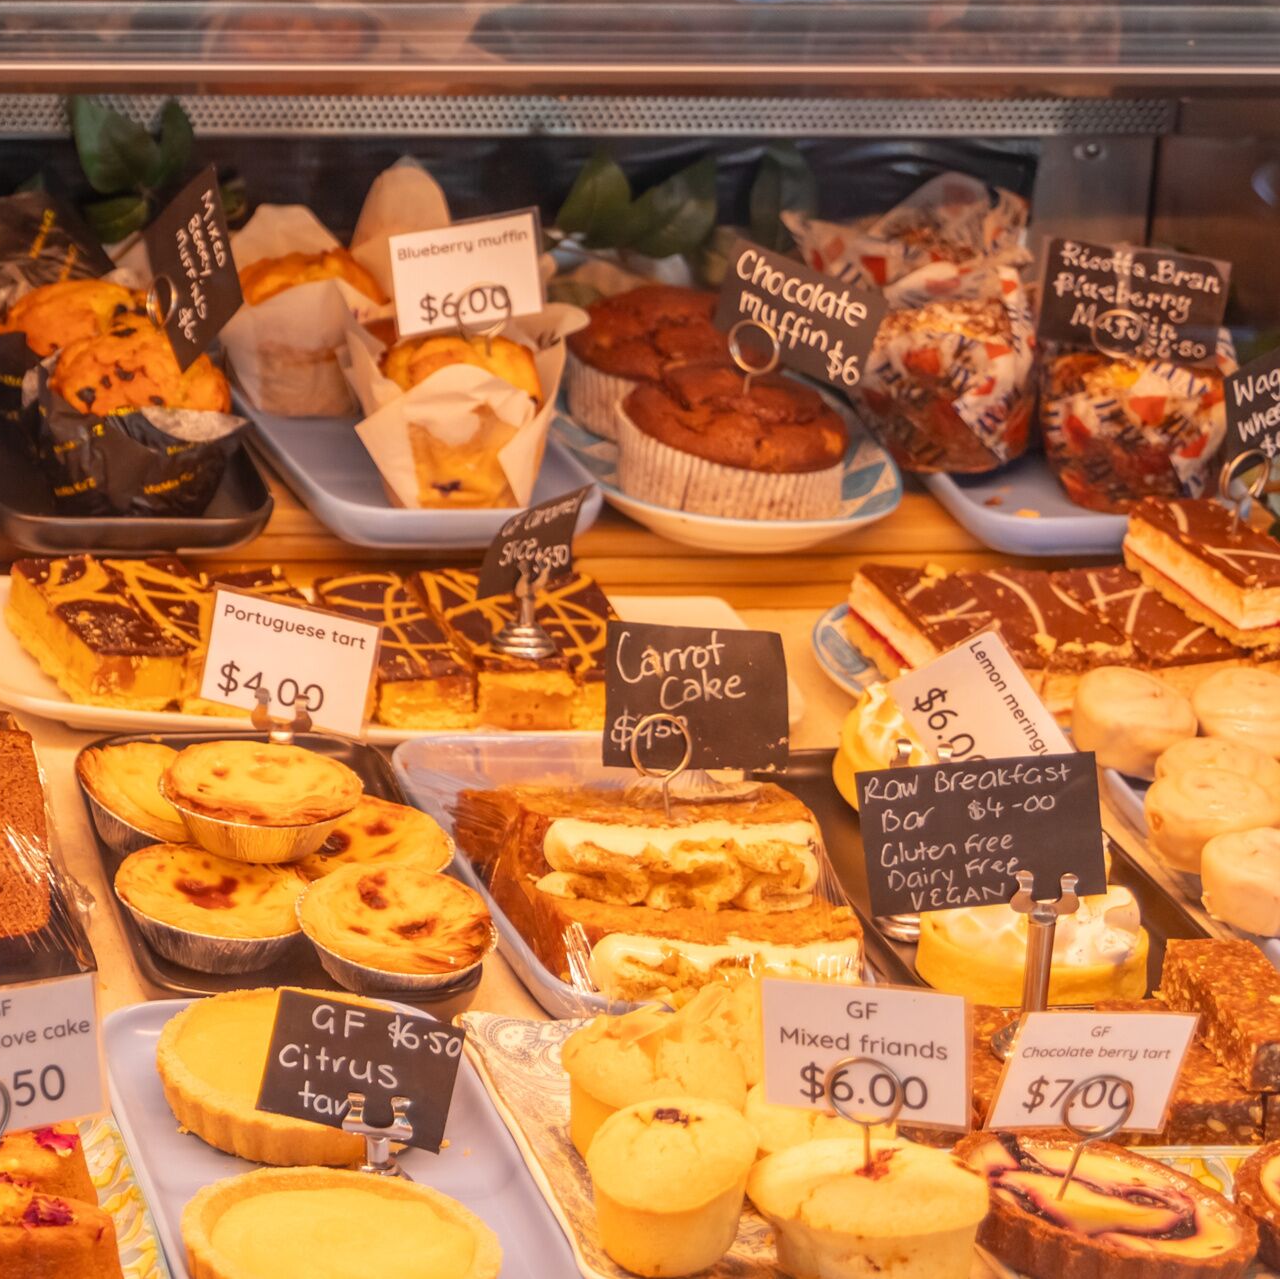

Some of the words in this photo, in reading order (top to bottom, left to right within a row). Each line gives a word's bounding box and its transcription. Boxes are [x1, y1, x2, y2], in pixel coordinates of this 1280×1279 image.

[397, 240, 474, 261] Blueberry
[478, 229, 528, 248] muffin
[736, 249, 867, 327] Chocolate
[1151, 259, 1221, 295] Bran
[419, 285, 510, 325] $6.00
[739, 290, 829, 353] muffin
[826, 339, 860, 386] $6
[224, 604, 326, 639] Portuguese
[332, 630, 366, 650] tart
[616, 630, 725, 683] Carrot
[969, 640, 1007, 692] Lemon
[217, 660, 324, 712] $400
[660, 669, 746, 710] Cake
[912, 687, 987, 761] $6.0
[864, 775, 918, 804] Raw
[934, 763, 1071, 793] Breakfast
[882, 807, 935, 833] Bar
[881, 842, 956, 868] Gluten
[888, 869, 954, 893] Dairy
[911, 883, 1005, 911] VEGAN
[846, 1000, 879, 1020] GF
[43, 1019, 90, 1041] cake
[387, 1015, 462, 1058] $6.50
[779, 1026, 850, 1051] Mixed
[859, 1034, 948, 1060] friands
[1091, 1026, 1111, 1038] GF
[278, 1044, 398, 1089] Citrus
[1022, 1046, 1094, 1059] Chocolate
[1098, 1046, 1139, 1061] berry
[1143, 1048, 1171, 1060] tart
[298, 1080, 350, 1115] tar
[799, 1062, 928, 1110] $6.00
[1022, 1075, 1131, 1114] $7.00
